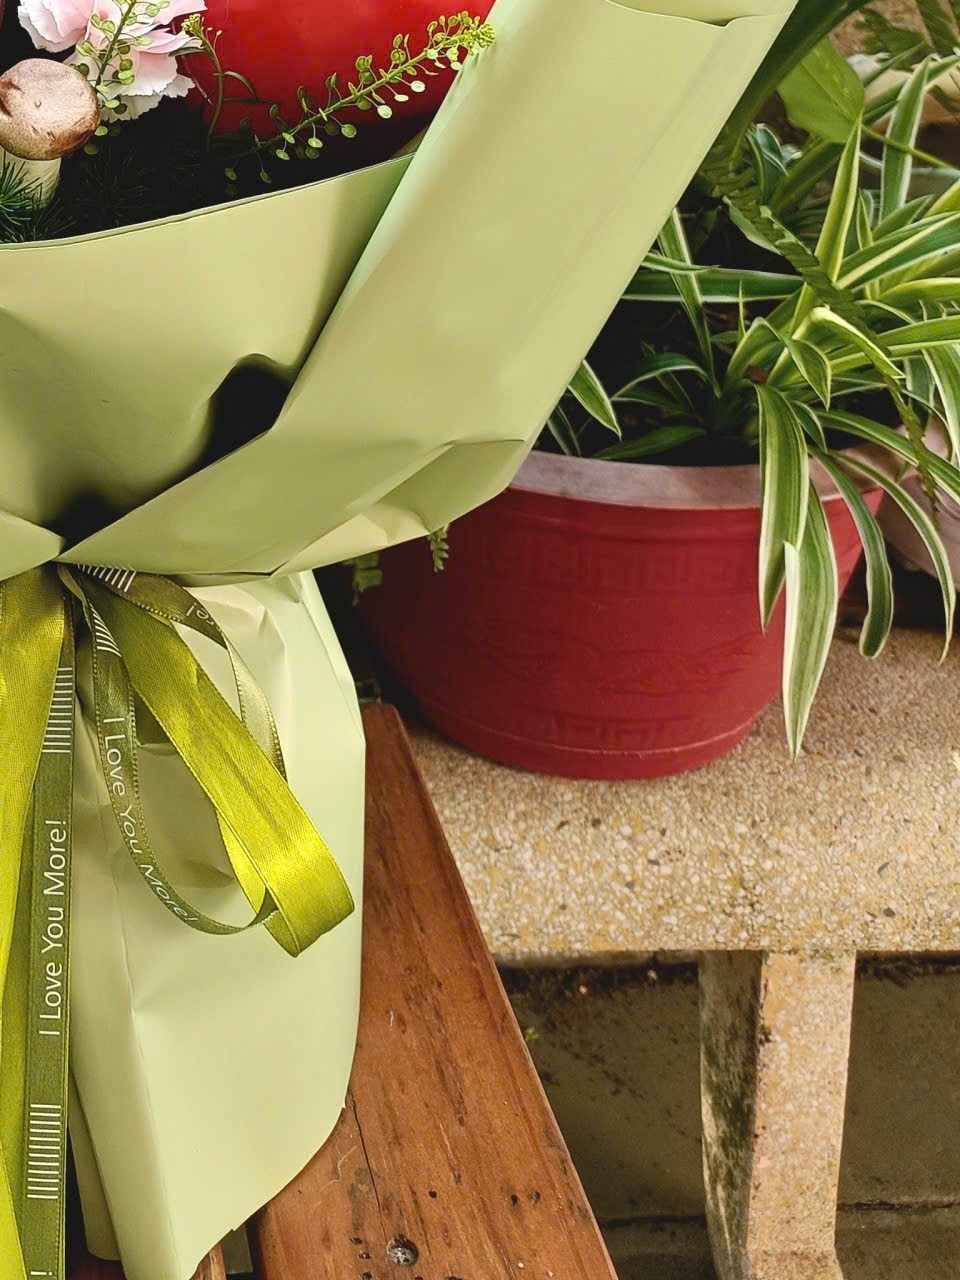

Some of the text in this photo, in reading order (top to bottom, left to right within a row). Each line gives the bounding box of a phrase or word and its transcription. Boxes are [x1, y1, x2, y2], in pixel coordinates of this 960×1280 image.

[43, 819, 67, 896] More!
[104, 734, 127, 796] Love
[119, 804, 142, 854] You
[140, 864, 199, 921] More!
[41, 906, 64, 954] You
[39, 961, 63, 1020] Love
